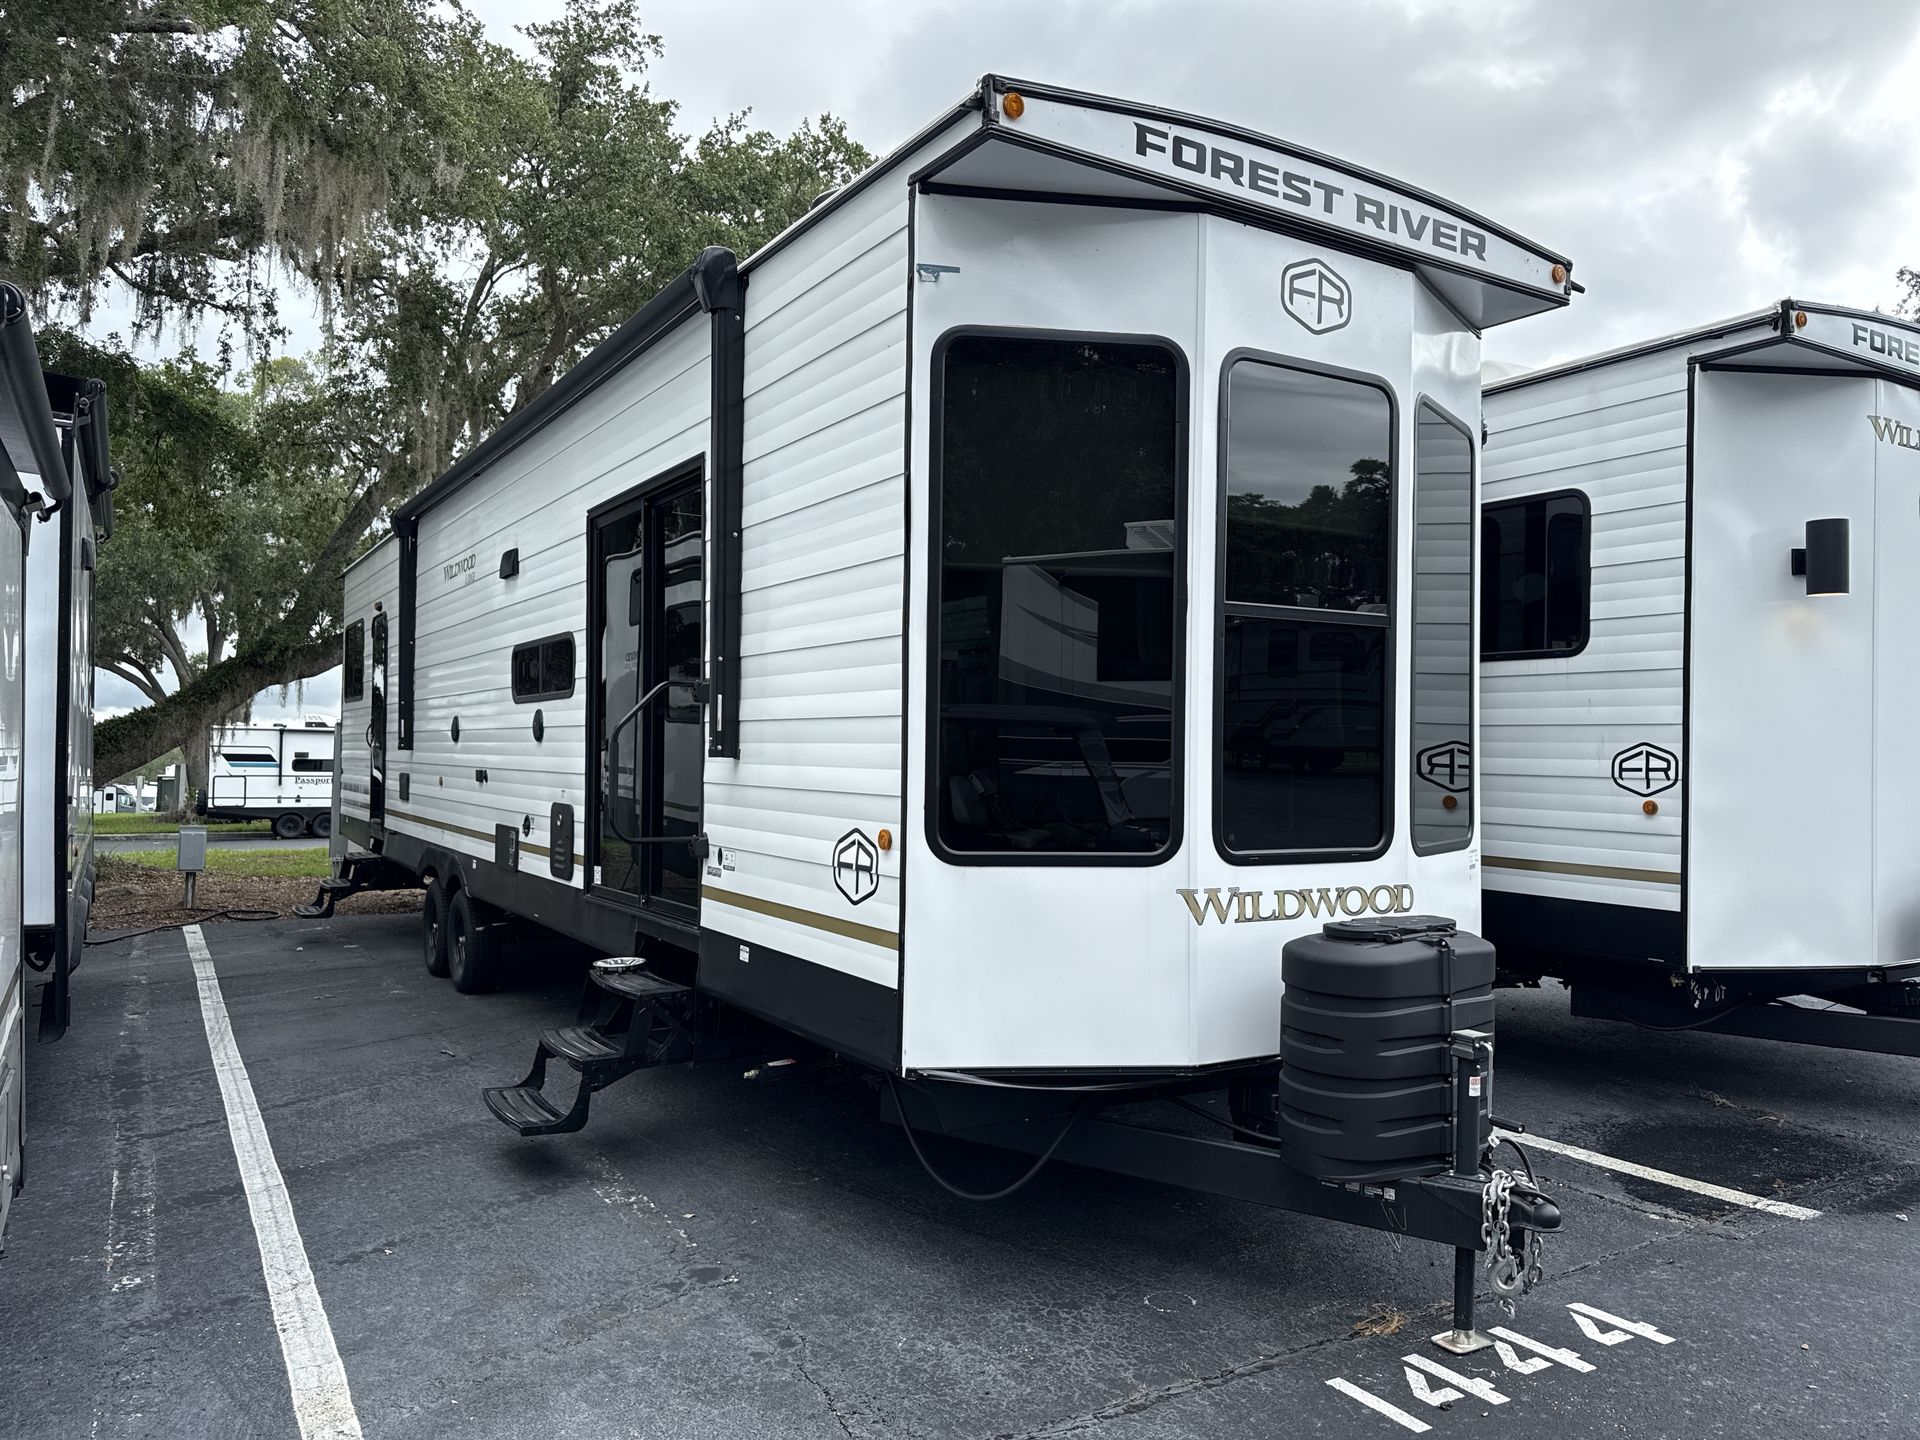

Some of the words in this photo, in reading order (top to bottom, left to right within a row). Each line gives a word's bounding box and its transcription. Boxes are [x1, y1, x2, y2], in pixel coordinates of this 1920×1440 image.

[1133, 121, 1343, 215] FOREST
[1354, 193, 1487, 263] RIVER
[1867, 414, 1920, 451] WIL
[1175, 883, 1415, 926] WILDWOOD
[1324, 1302, 1677, 1434] 1444
